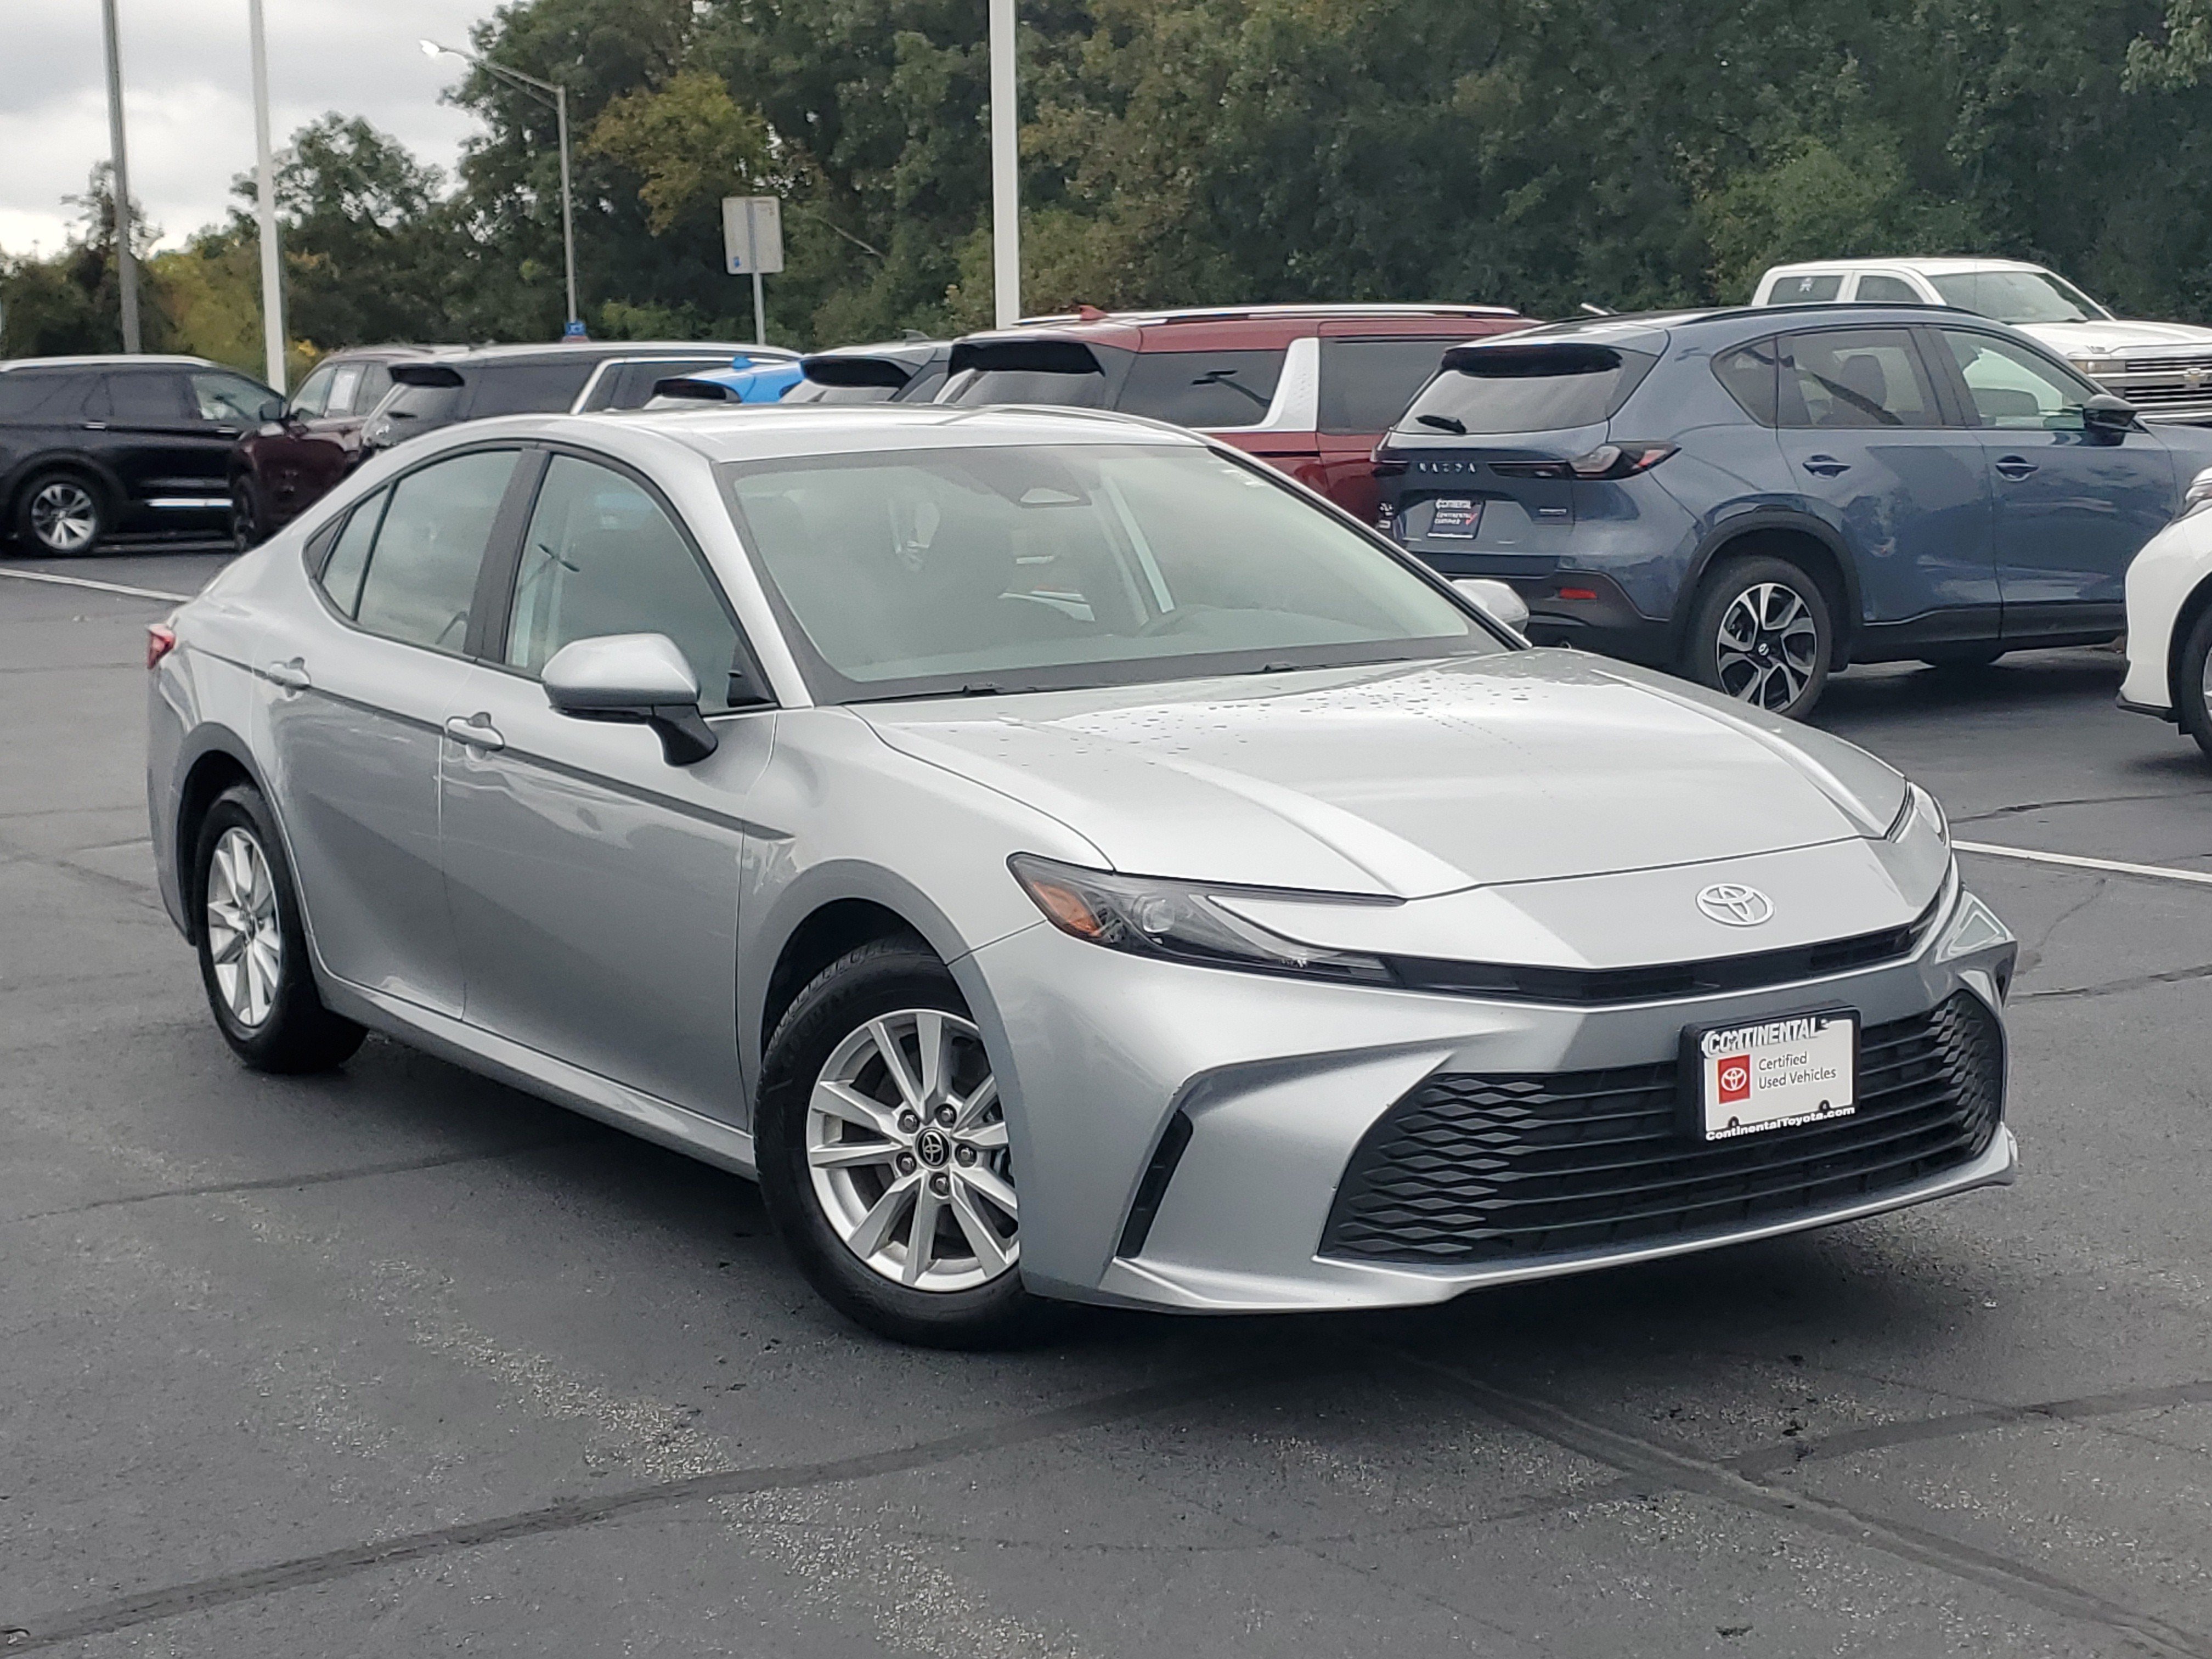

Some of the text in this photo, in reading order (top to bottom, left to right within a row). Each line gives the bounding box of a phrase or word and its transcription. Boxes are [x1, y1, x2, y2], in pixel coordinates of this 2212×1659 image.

[1702, 1017, 1818, 1056] CONTINENTAL
[1759, 1050, 1807, 1071] Certified
[1759, 1066, 1836, 1089] Used Vehicles
[1705, 1107, 1855, 1141] ContinentalToyota.com
